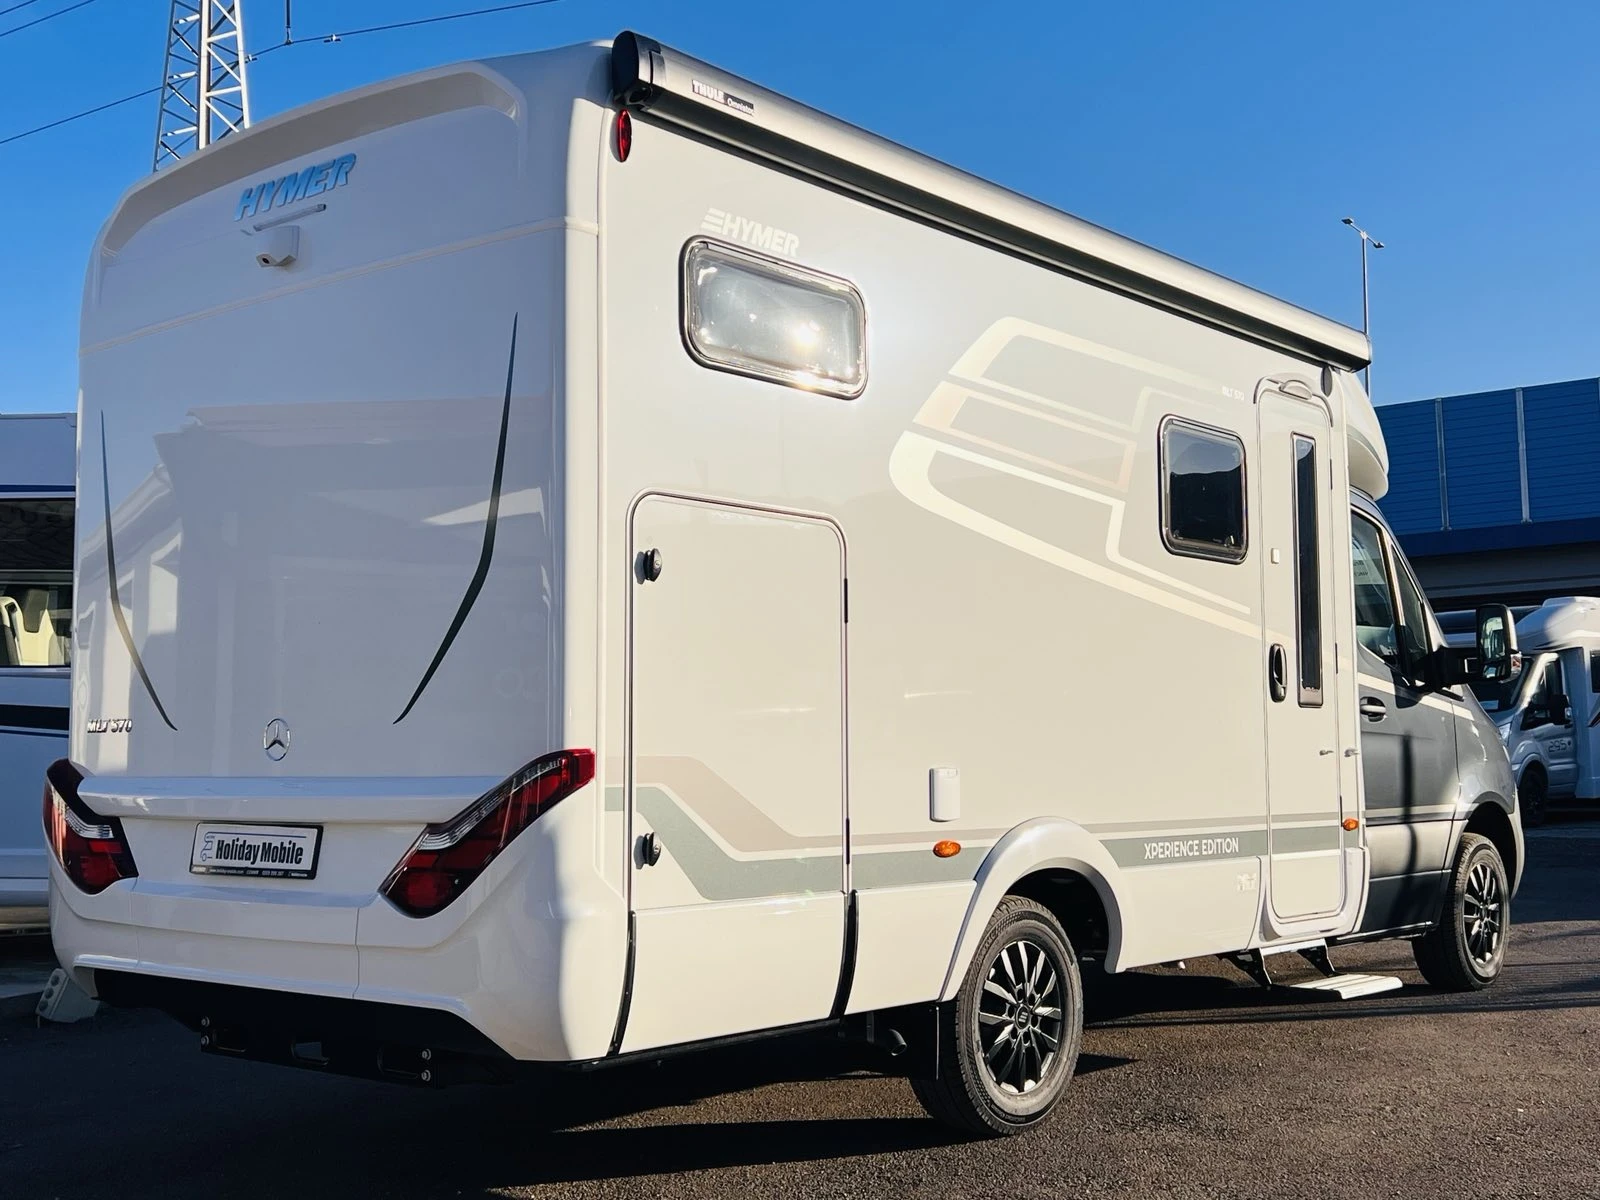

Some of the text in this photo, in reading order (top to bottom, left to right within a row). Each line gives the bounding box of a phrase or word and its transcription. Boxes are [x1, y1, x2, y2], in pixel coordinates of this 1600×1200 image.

[692, 79, 725, 104] THULE
[234, 152, 357, 222] HYMER
[722, 211, 800, 258] HYMER
[110, 718, 132, 733] 570
[215, 837, 304, 865] Holiday Mobile
[1144, 837, 1239, 860] XPERIENCE EDITION
